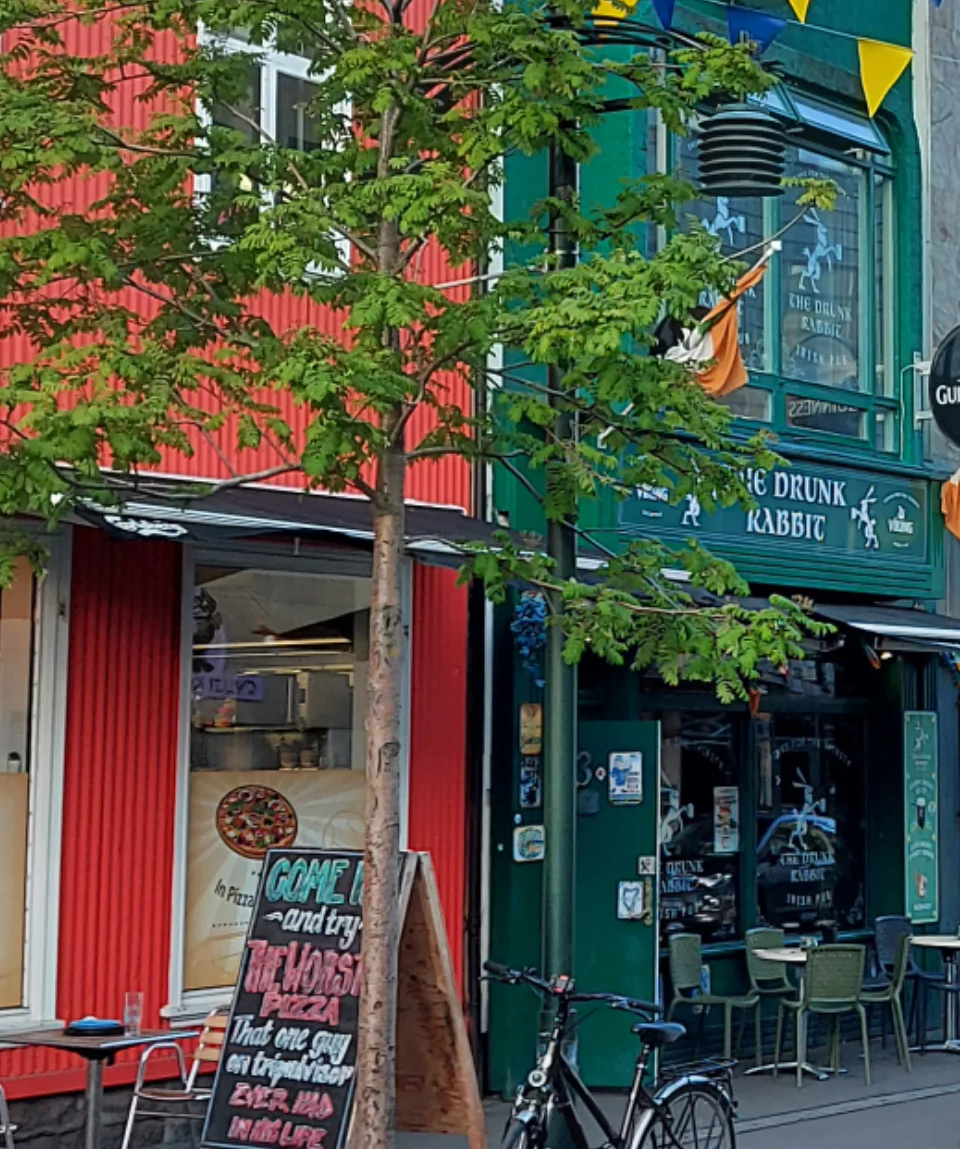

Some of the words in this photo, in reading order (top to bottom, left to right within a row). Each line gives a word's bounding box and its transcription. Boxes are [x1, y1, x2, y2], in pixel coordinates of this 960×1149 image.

[788, 292, 812, 312] THE
[815, 300, 852, 321] DRUNK
[800, 316, 842, 338] RABBIT
[772, 471, 847, 507] DRUNK
[746, 507, 826, 542] RABBIT
[265, 857, 350, 904] COME
[325, 909, 360, 950] try
[244, 940, 288, 994] THE
[259, 991, 340, 1026] PIZZA
[230, 1014, 274, 1047] That
[275, 1027, 309, 1050] one
[309, 1030, 352, 1065] guy
[225, 1053, 251, 1076] on
[229, 1082, 290, 1114] EVER
